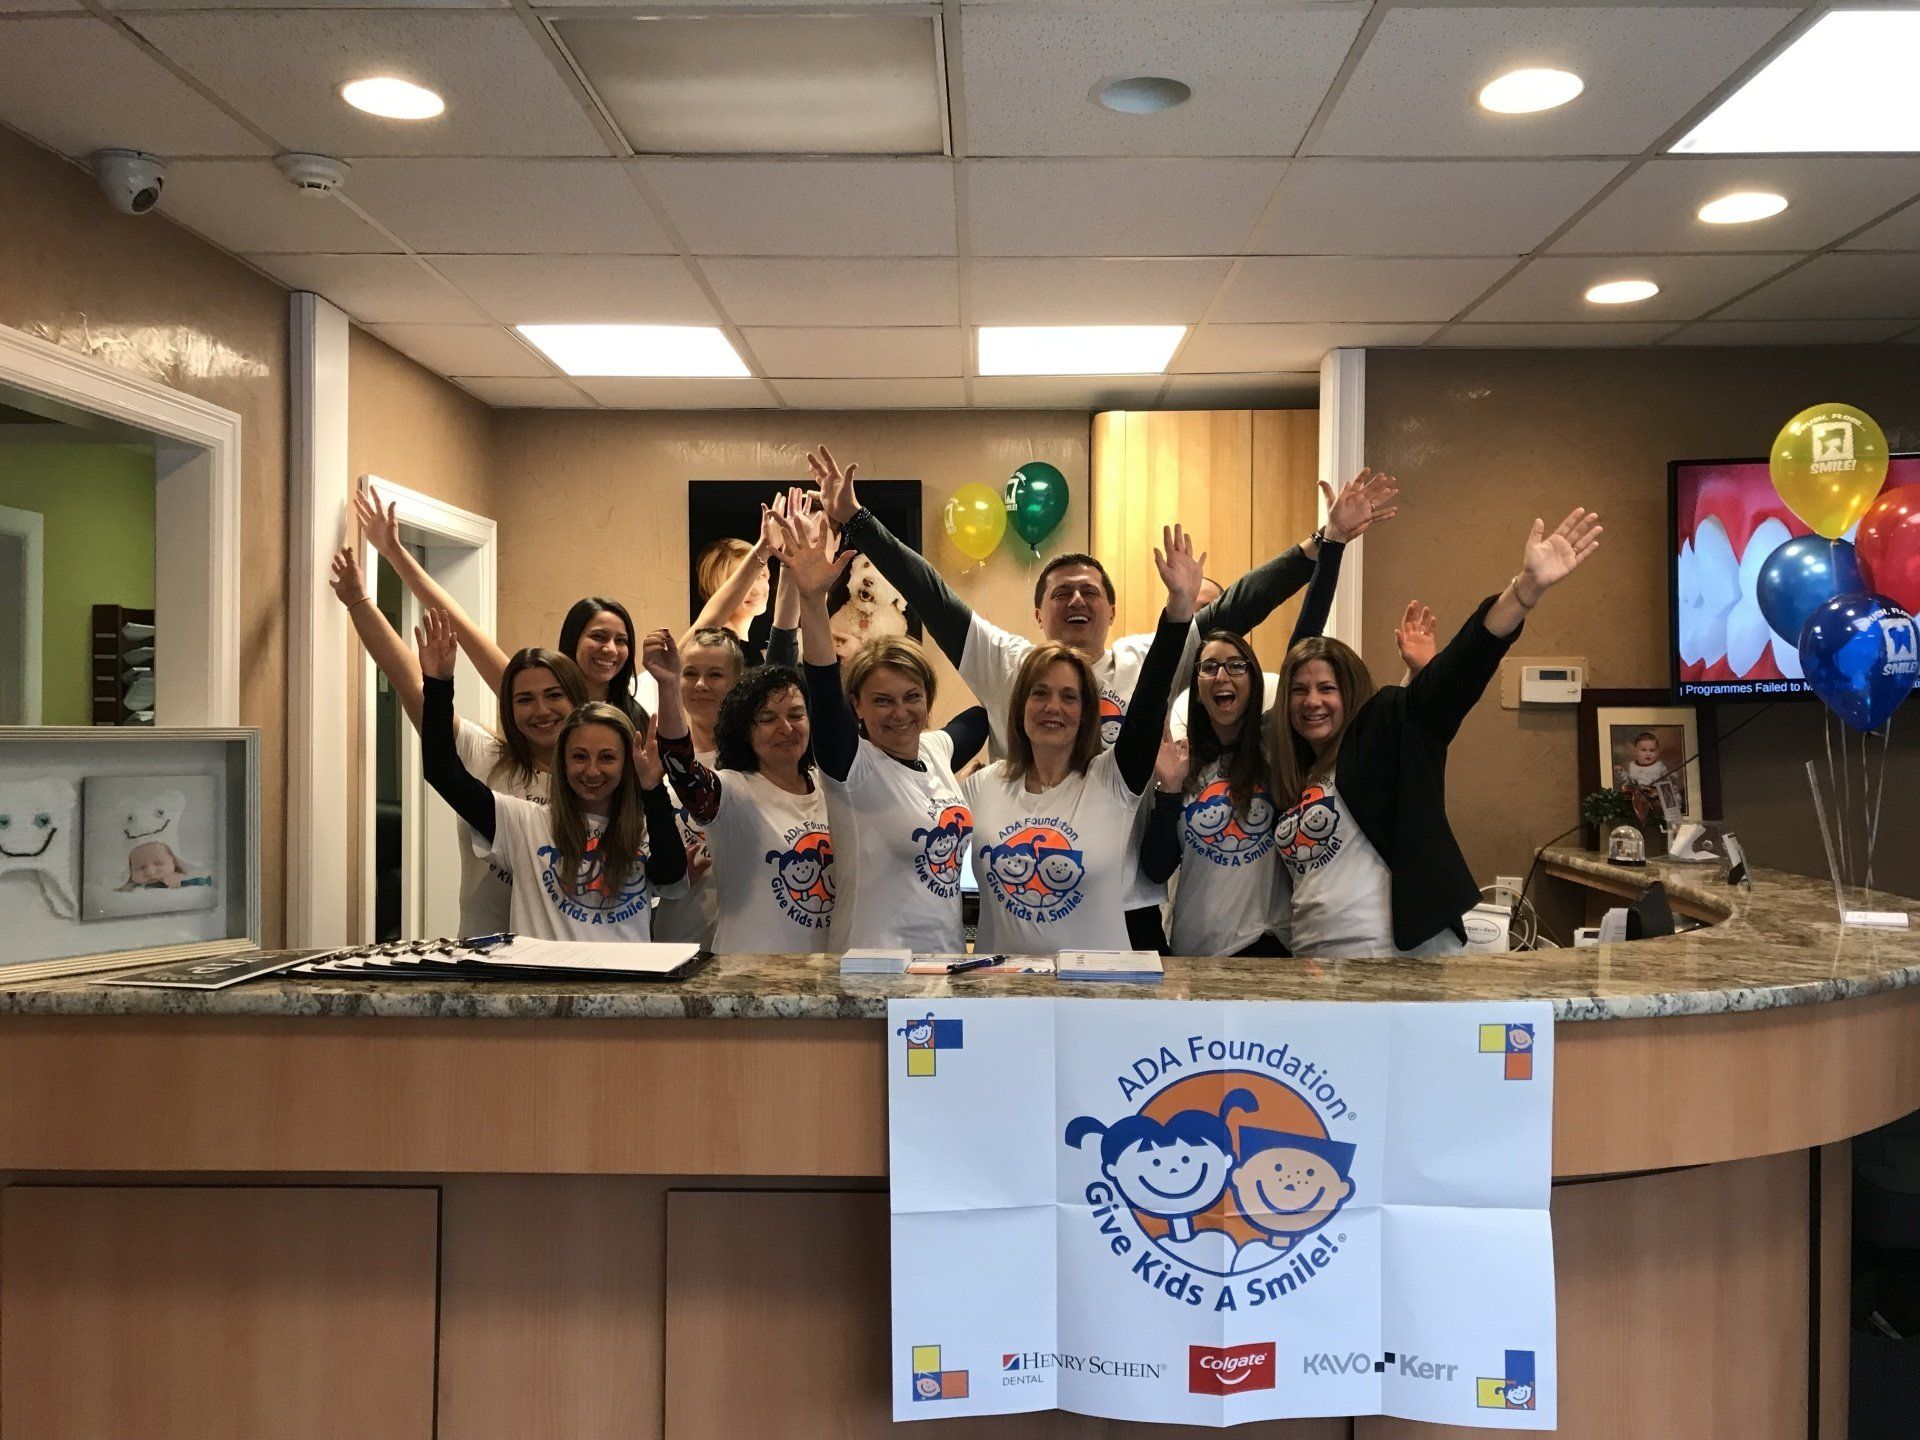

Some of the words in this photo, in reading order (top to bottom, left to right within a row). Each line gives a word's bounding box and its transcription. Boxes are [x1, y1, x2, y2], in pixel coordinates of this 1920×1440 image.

[1810, 459, 1857, 475] SMILE!
[1099, 685, 1126, 708] ation
[1686, 683, 1753, 696] Programmes
[1755, 681, 1787, 693] Failed
[1790, 682, 1801, 692] to
[1803, 681, 1813, 692] M
[784, 826, 804, 844] ADA
[998, 821, 1022, 840] ADA
[1184, 830, 1205, 855] Give
[1205, 848, 1229, 867] Kds
[1231, 856, 1241, 868] A
[914, 854, 928, 883] Give
[927, 879, 948, 898] Kids
[543, 870, 559, 902] Give
[559, 899, 589, 923] Kids
[592, 912, 603, 925] A
[607, 895, 648, 924] Smile!
[771, 878, 788, 909] Give
[787, 905, 813, 928] Kids
[815, 917, 823, 929] A
[986, 872, 1005, 902] Give
[1005, 899, 1032, 921] Kids
[1036, 911, 1046, 924] A
[1049, 891, 1084, 922] Smile!
[1117, 1046, 1183, 1102] ADA
[1187, 1035, 1348, 1120] Foundation
[1085, 1181, 1132, 1257] Give
[1131, 1250, 1205, 1306] Kids
[1214, 1286, 1238, 1312] A
[1246, 1233, 1339, 1306] Smile!
[1022, 1351, 1087, 1372] HENRY
[1088, 1356, 1161, 1379] SCHEIN
[1200, 1353, 1266, 1373] Colgate
[1303, 1352, 1371, 1376] KAVO
[1400, 1354, 1459, 1382] Kerr
[1002, 1374, 1044, 1387] DENTAL
